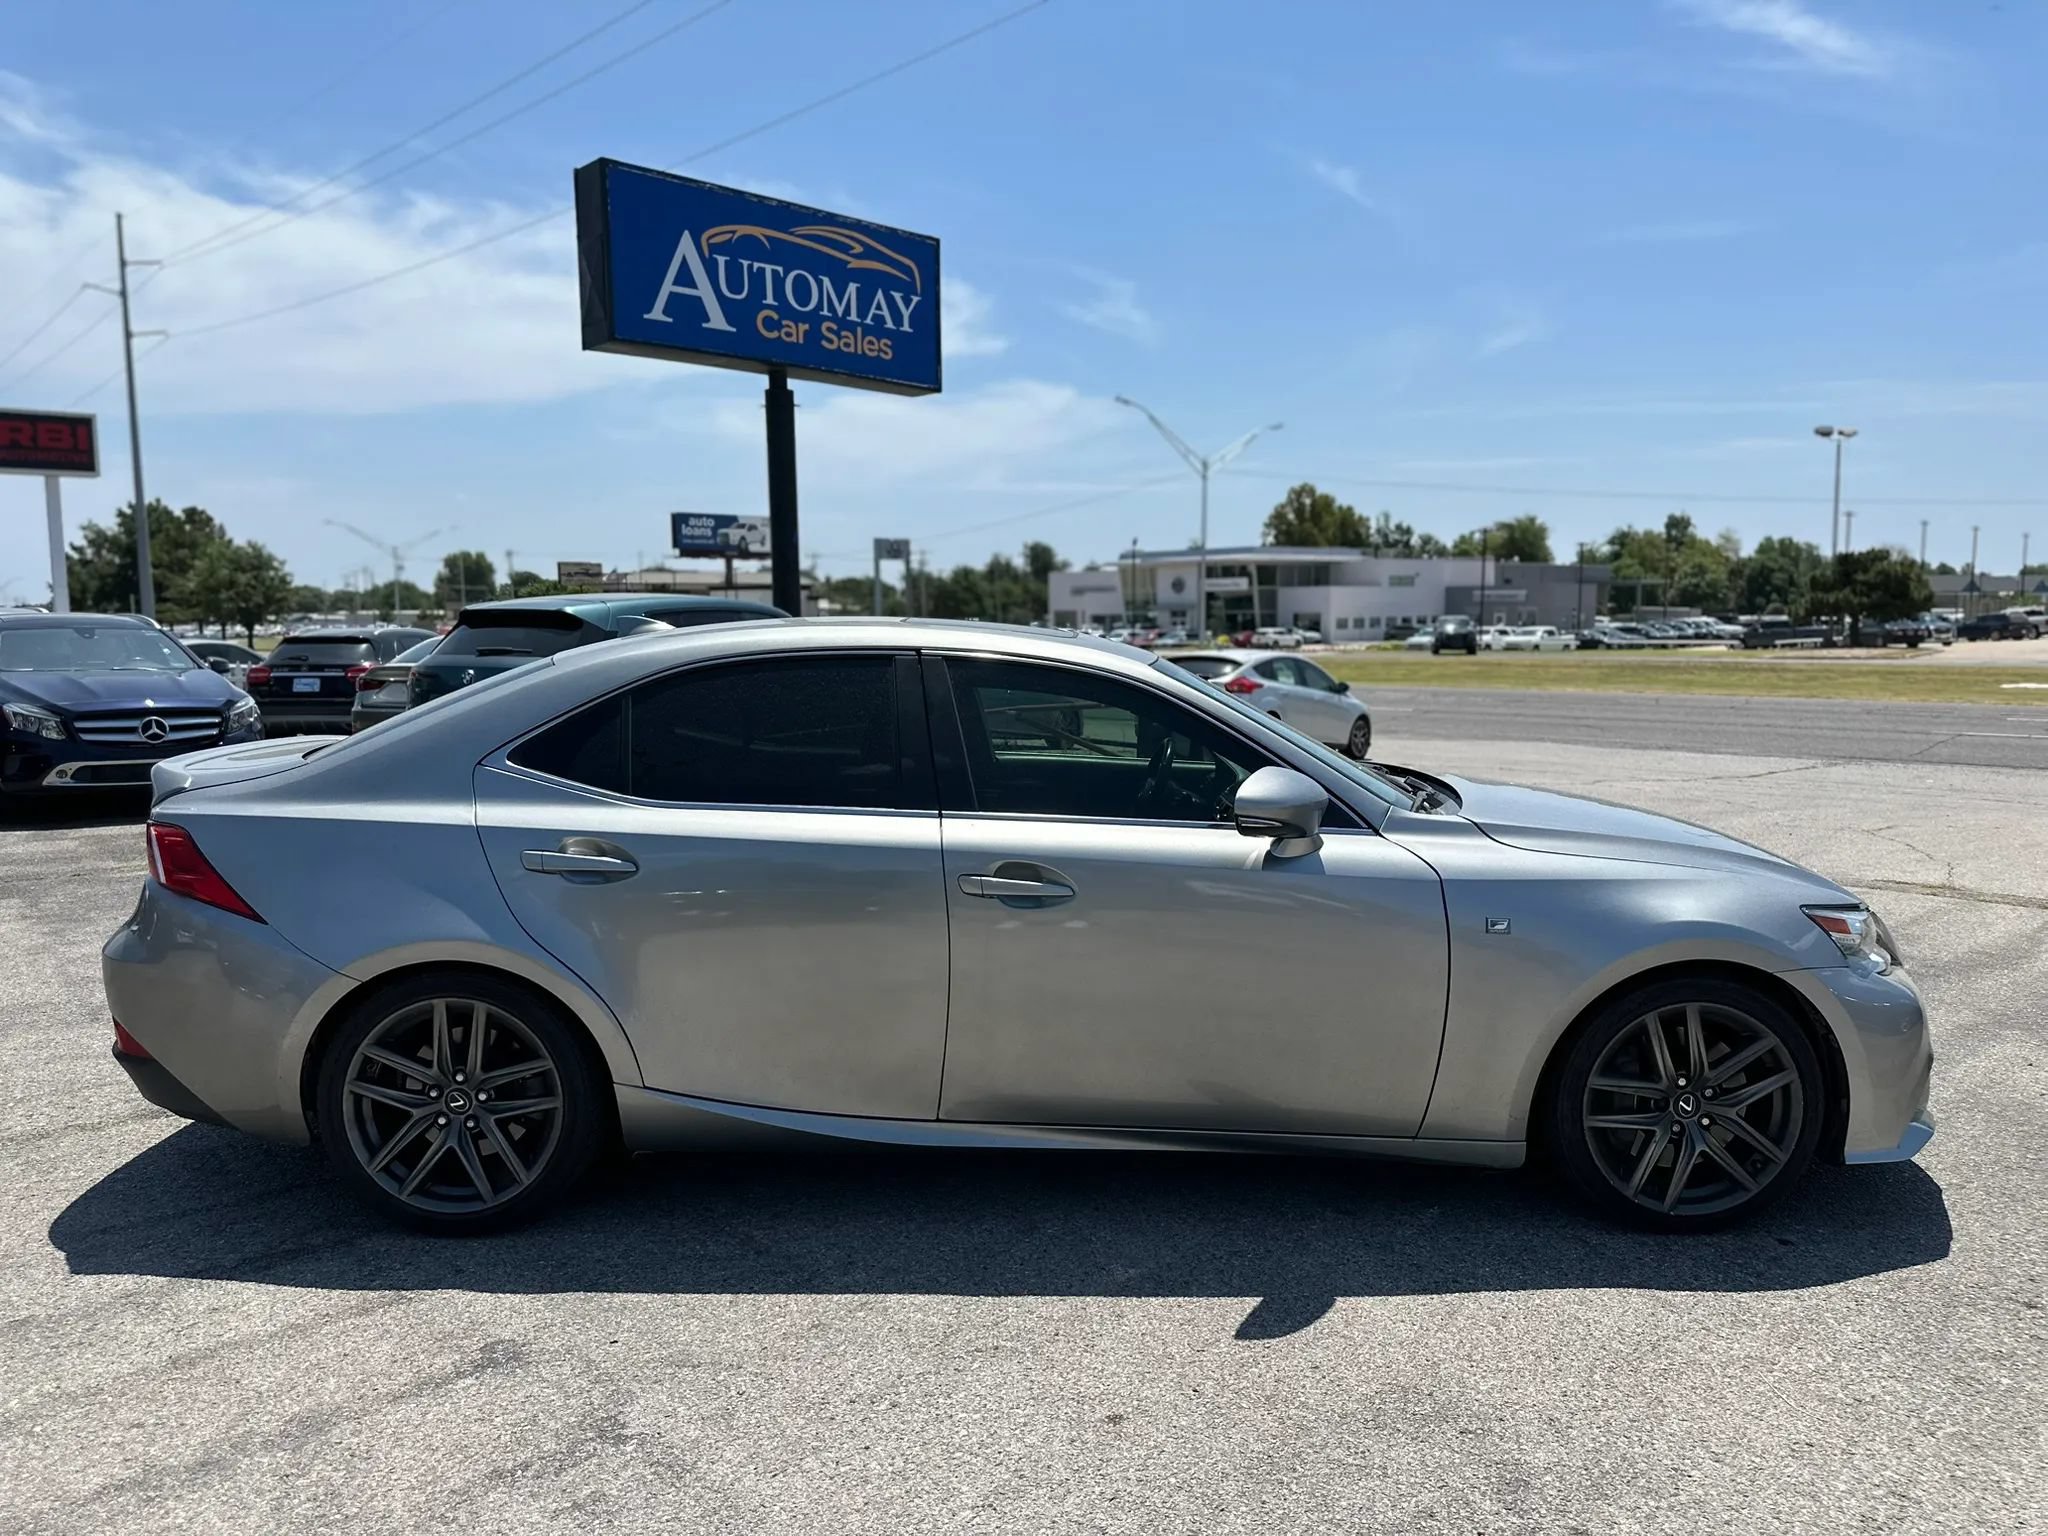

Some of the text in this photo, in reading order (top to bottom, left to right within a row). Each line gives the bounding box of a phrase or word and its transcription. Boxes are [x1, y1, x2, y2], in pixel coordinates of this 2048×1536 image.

[643, 229, 921, 332] AUTOMAY
[756, 309, 893, 360] Car Sales
[681, 524, 713, 537] loans
[688, 517, 715, 527] auto
